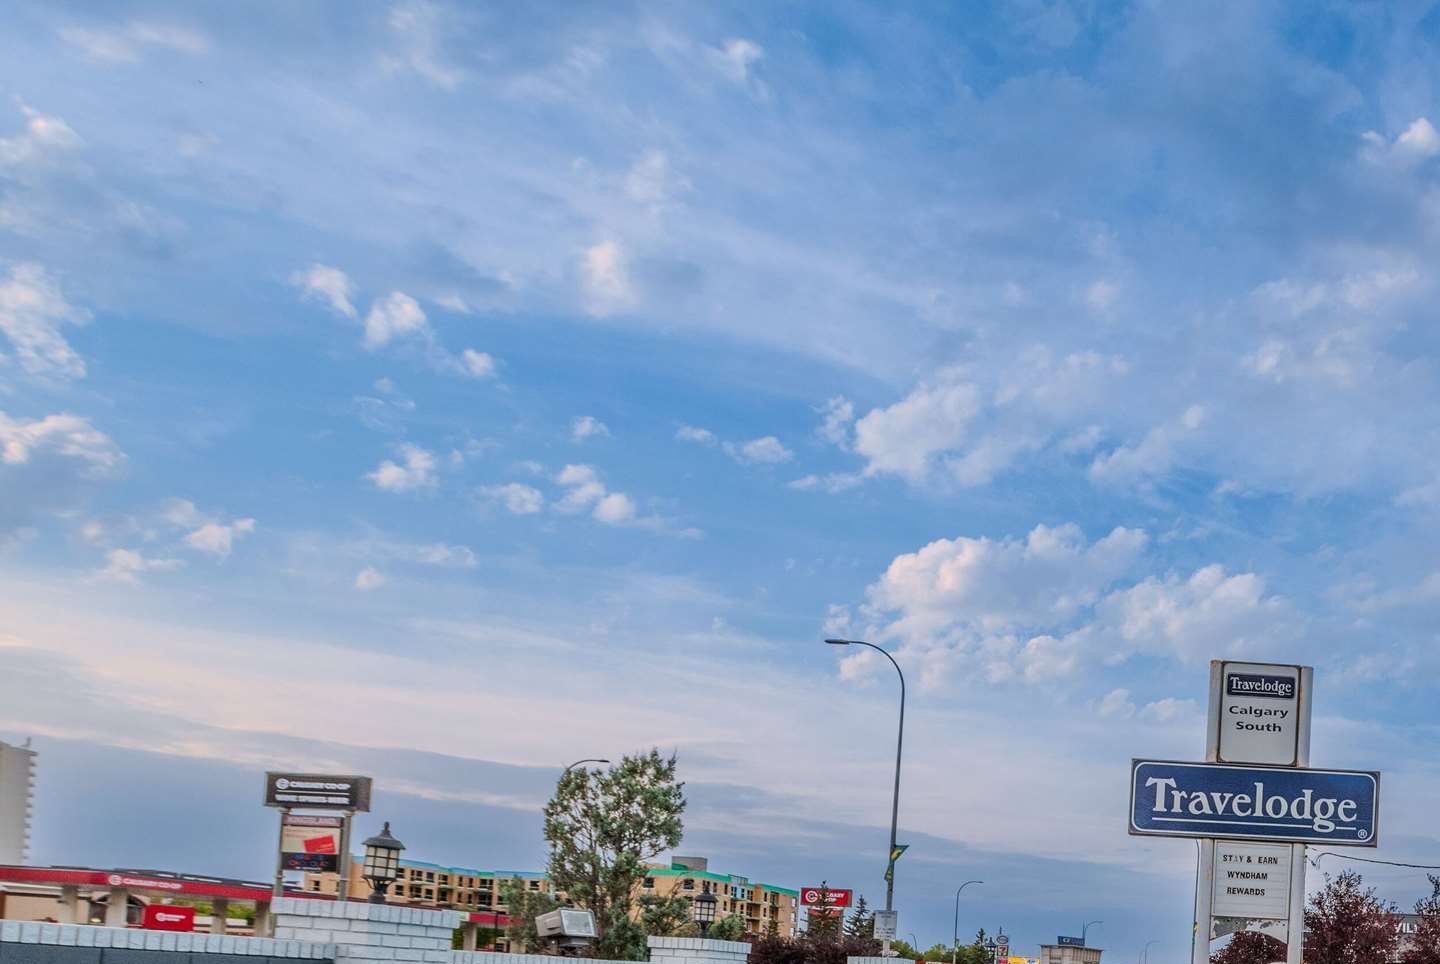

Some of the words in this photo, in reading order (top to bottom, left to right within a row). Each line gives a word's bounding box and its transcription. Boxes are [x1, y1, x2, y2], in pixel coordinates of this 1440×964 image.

[1230, 677, 1292, 696] Travelodge
[1229, 705, 1289, 718] Calgary
[1235, 721, 1282, 732] South
[1145, 776, 1357, 833] Travelodge
[1258, 856, 1278, 865] EARN
[1227, 871, 1268, 880] WYNDHAM
[1227, 887, 1265, 896] REWARDS
